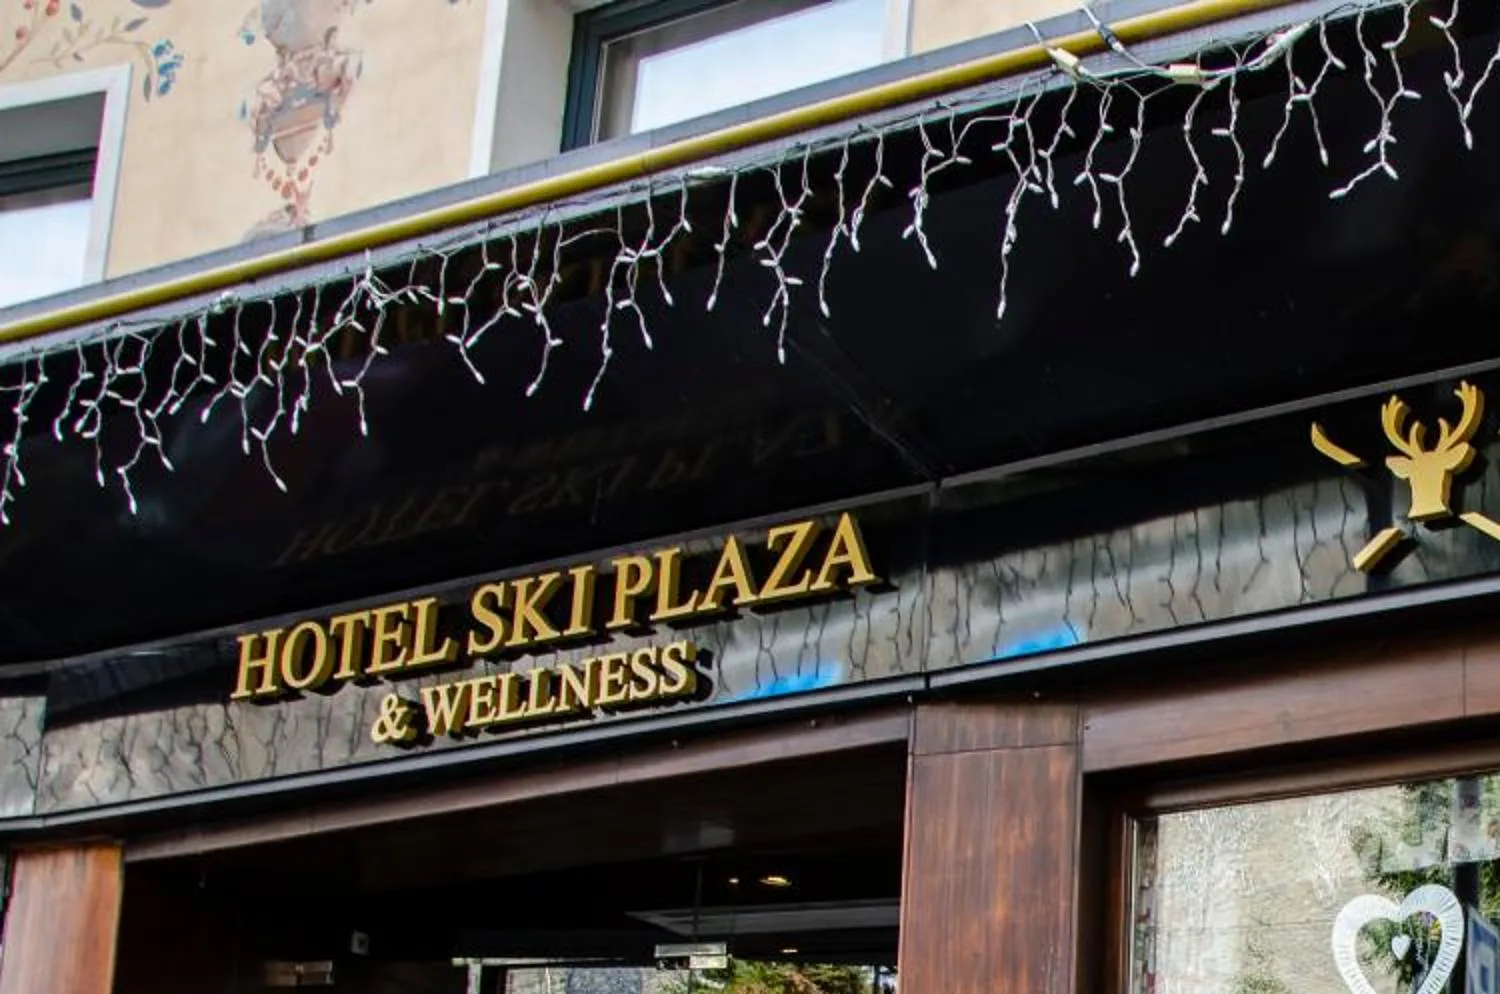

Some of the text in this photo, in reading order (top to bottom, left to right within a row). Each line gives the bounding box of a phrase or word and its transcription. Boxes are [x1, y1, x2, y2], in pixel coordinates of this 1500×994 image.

[229, 511, 882, 699] HOTEL SKI PLAZA
[370, 639, 699, 743] & WELLNESS
